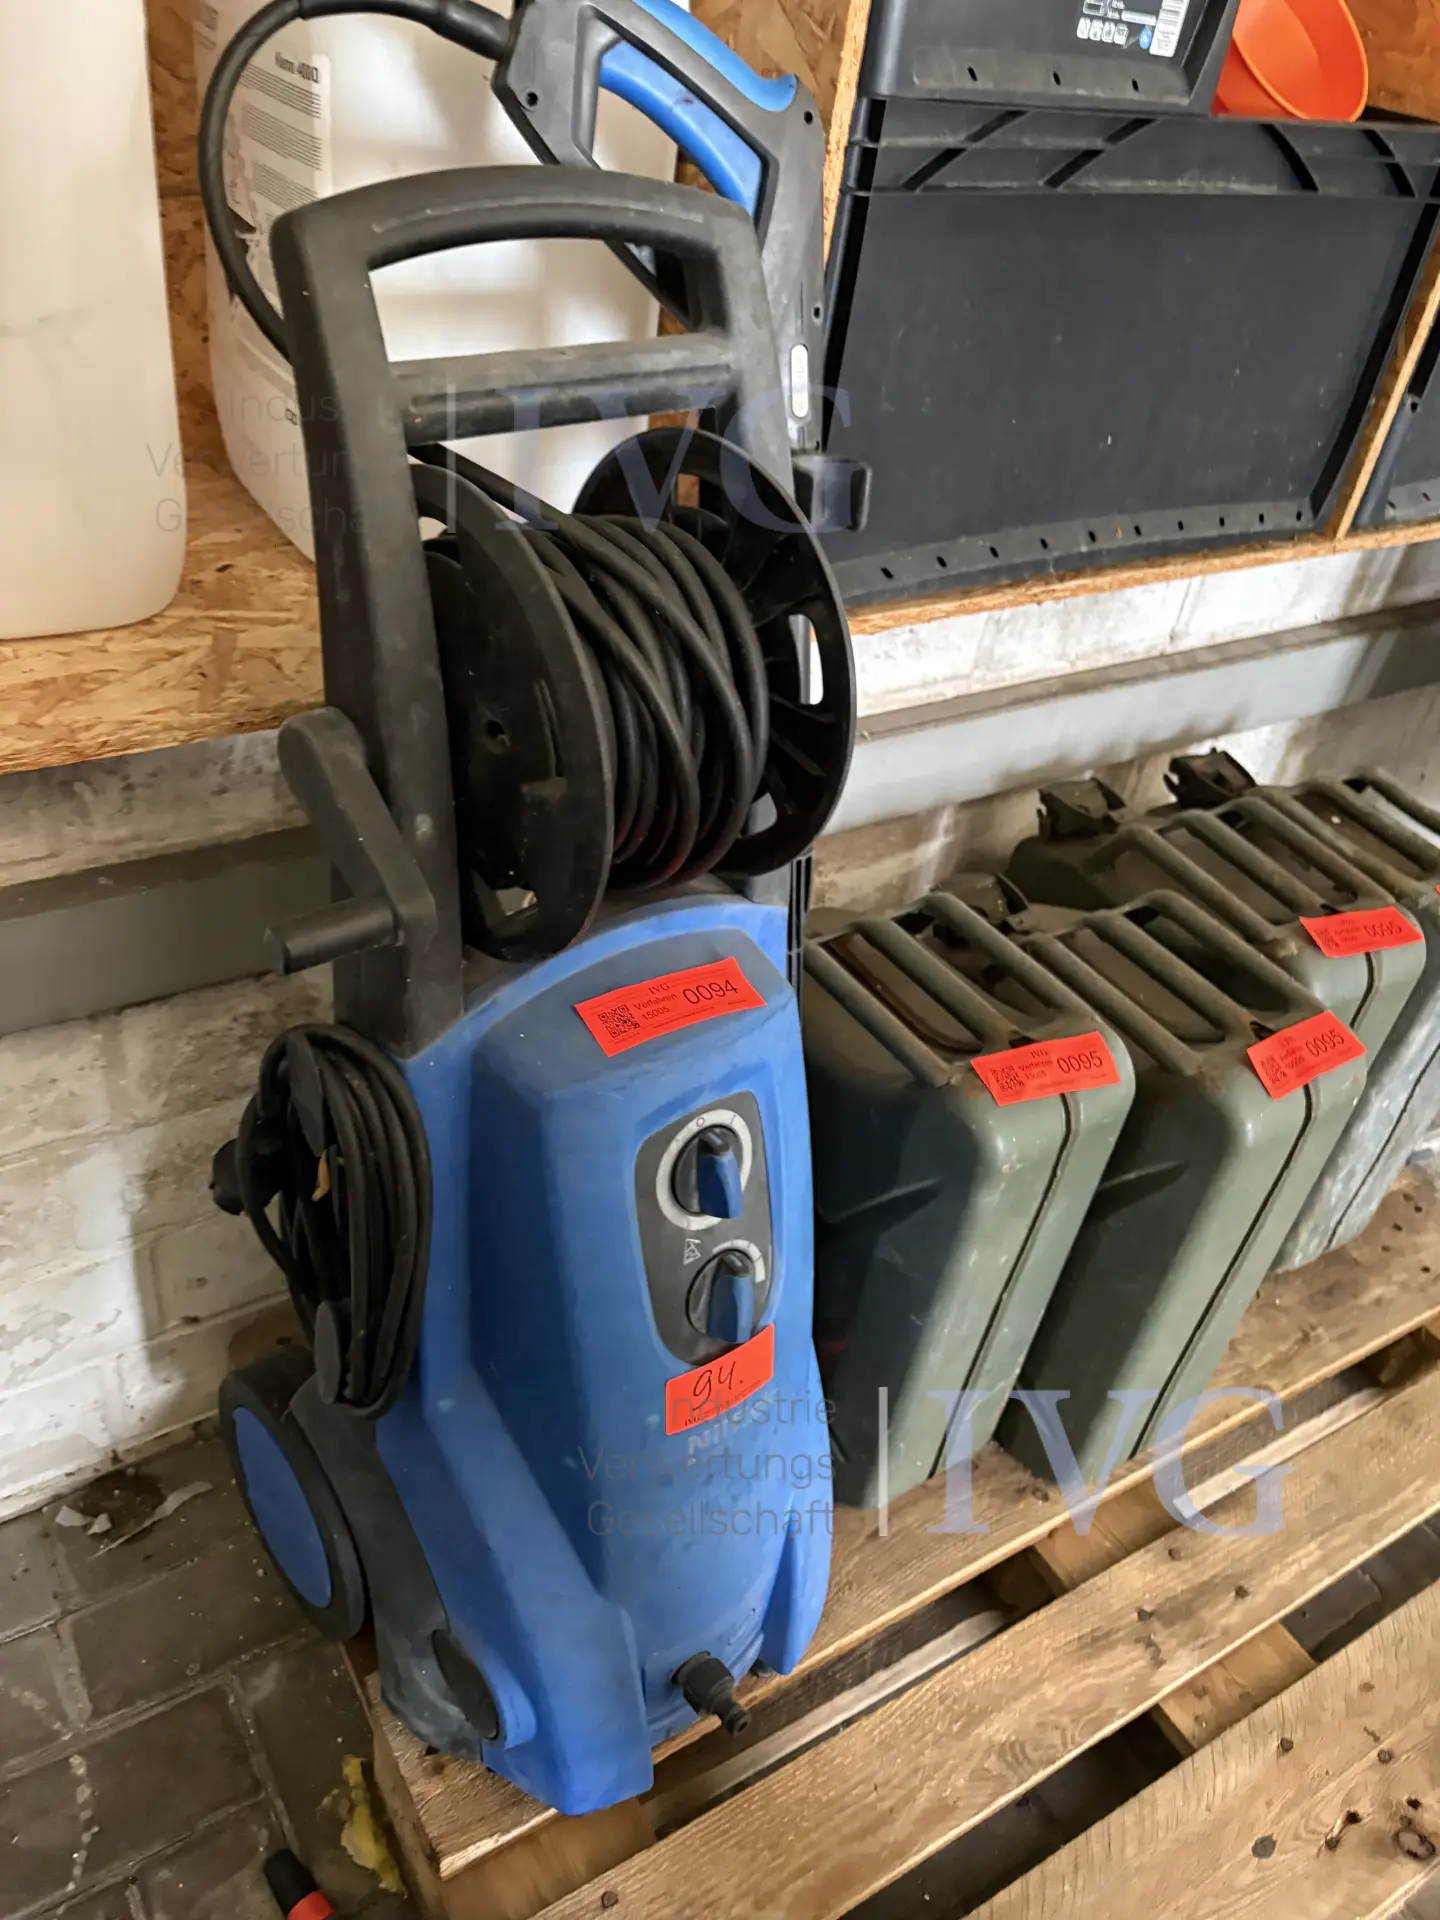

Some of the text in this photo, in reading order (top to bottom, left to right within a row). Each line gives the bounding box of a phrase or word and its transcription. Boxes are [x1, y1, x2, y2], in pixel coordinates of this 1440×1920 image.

[648, 982, 670, 996] IVG
[682, 979, 738, 1005] 0094
[633, 992, 678, 1011] Verfahren
[641, 1005, 670, 1021] 15005
[1305, 1027, 1345, 1058] 0095
[1056, 1050, 1103, 1075] 0095
